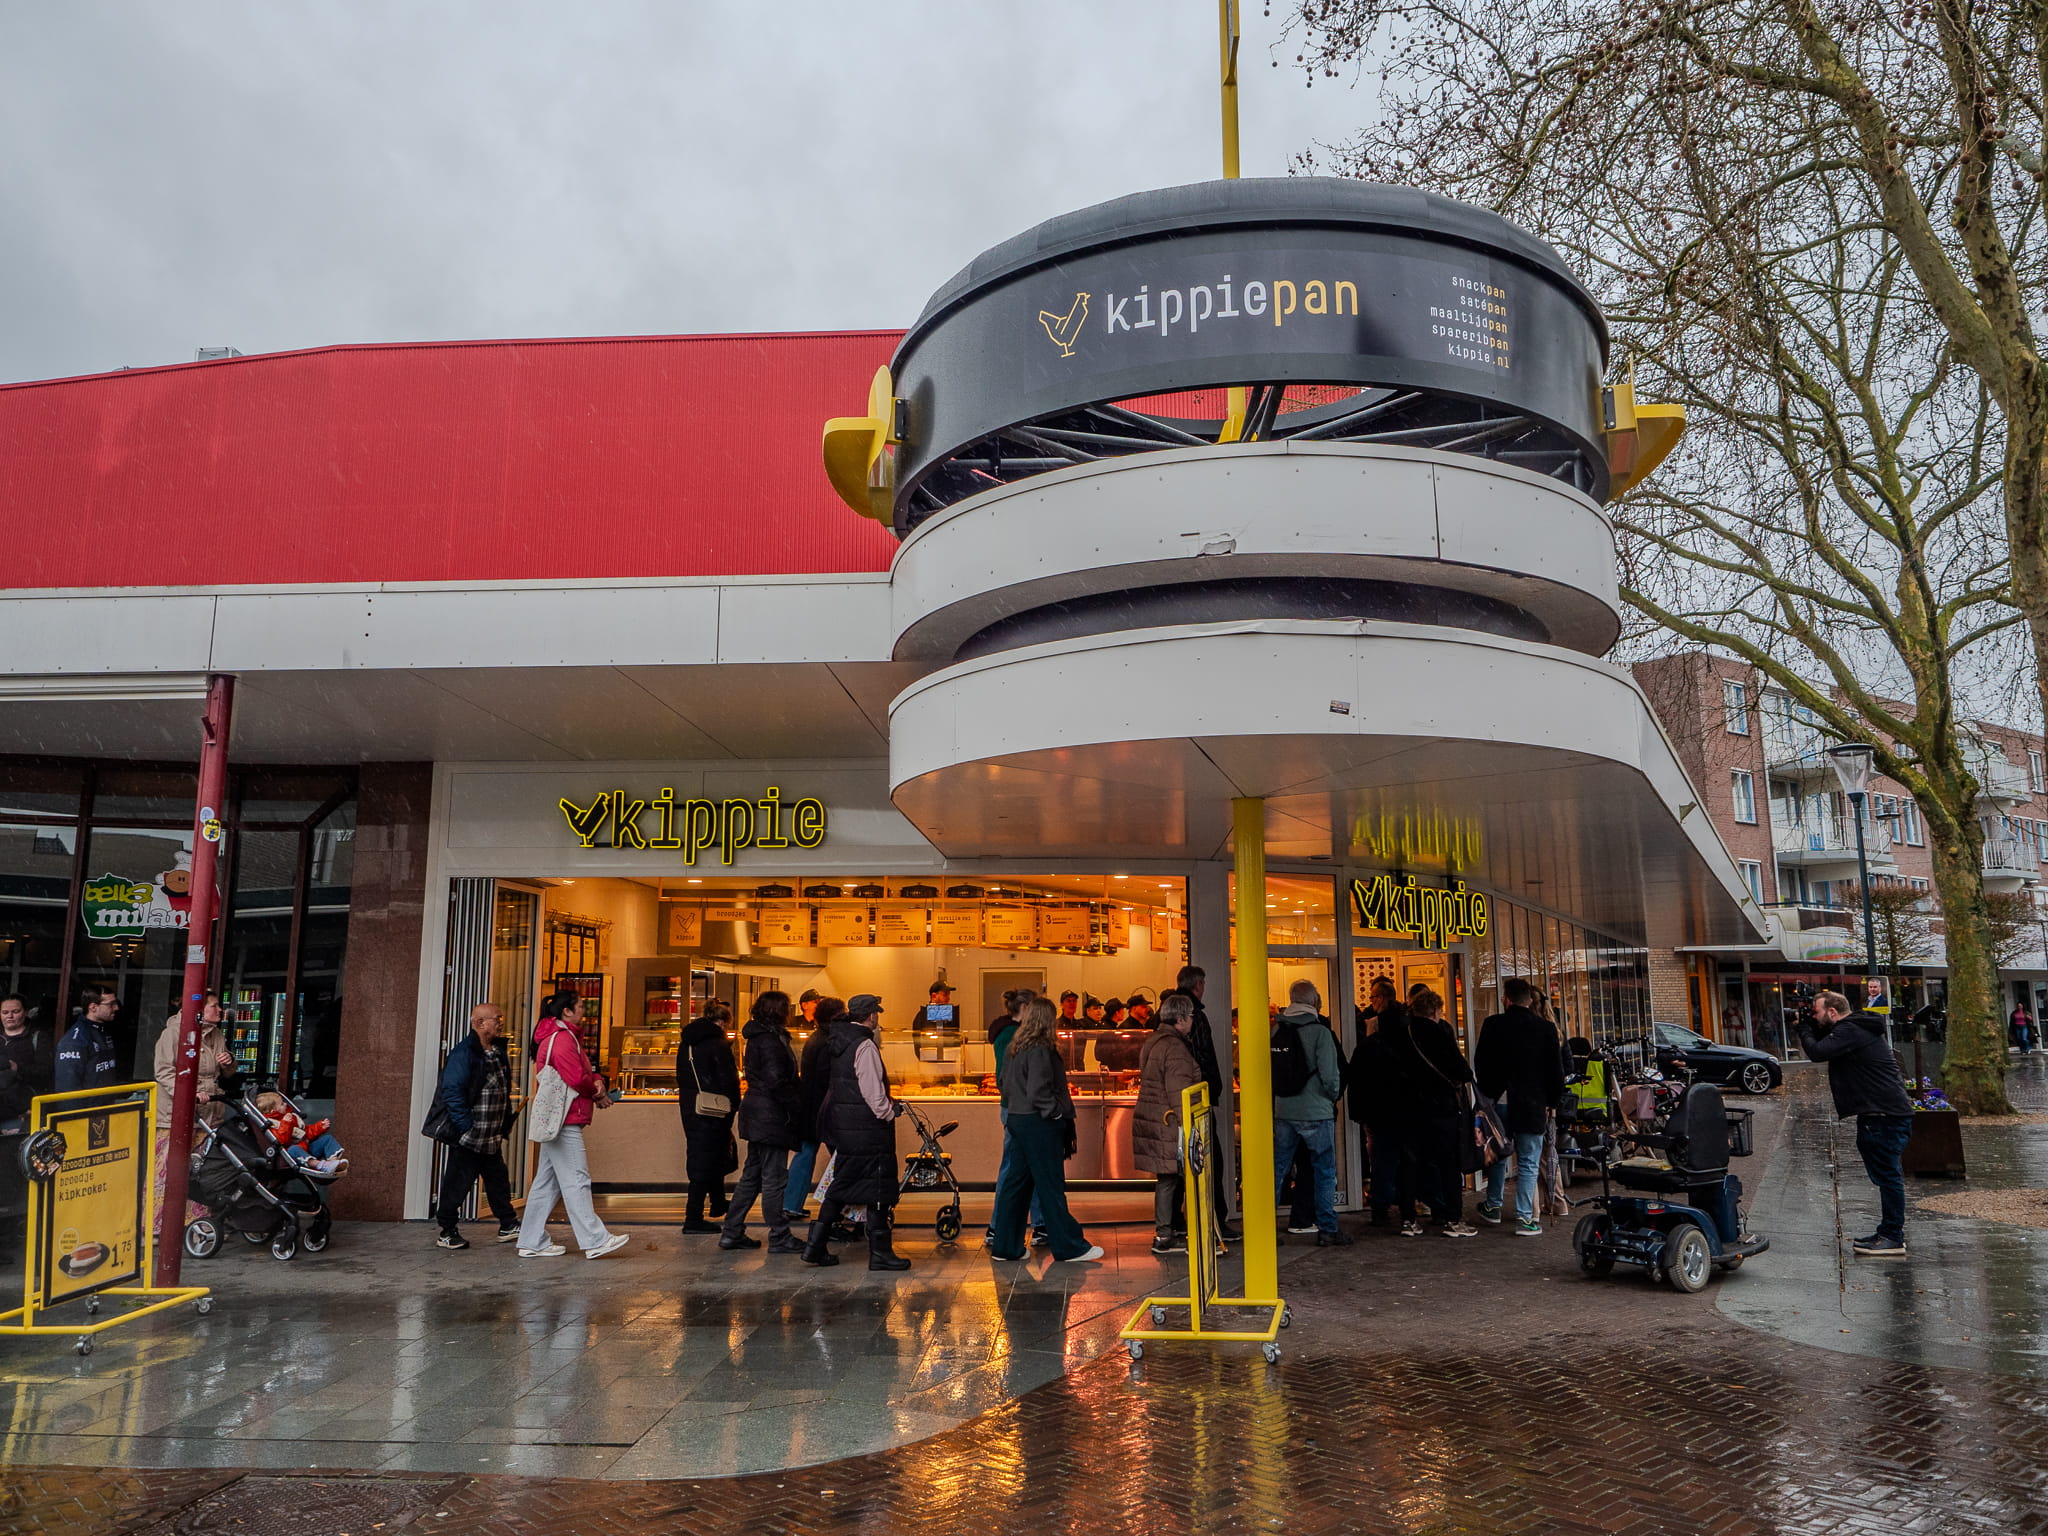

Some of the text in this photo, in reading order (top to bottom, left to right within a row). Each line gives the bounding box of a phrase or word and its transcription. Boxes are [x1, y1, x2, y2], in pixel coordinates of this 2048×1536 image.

[1452, 276, 1505, 299] snackpan
[1106, 274, 1359, 337] kippiepan
[1460, 295, 1506, 317] satépan
[1430, 306, 1508, 333] maaltijdpan
[1432, 324, 1509, 351] spareribpan
[1448, 343, 1510, 368] kippie.nl
[611, 787, 825, 865] kippie
[85, 884, 153, 904] bella
[94, 902, 192, 927] milan
[1383, 874, 1487, 950] kippie
[62, 1159, 91, 1170] Broodje
[92, 1155, 104, 1165] van
[58, 1182, 108, 1201] kipkroket
[60, 1171, 94, 1187] broodje
